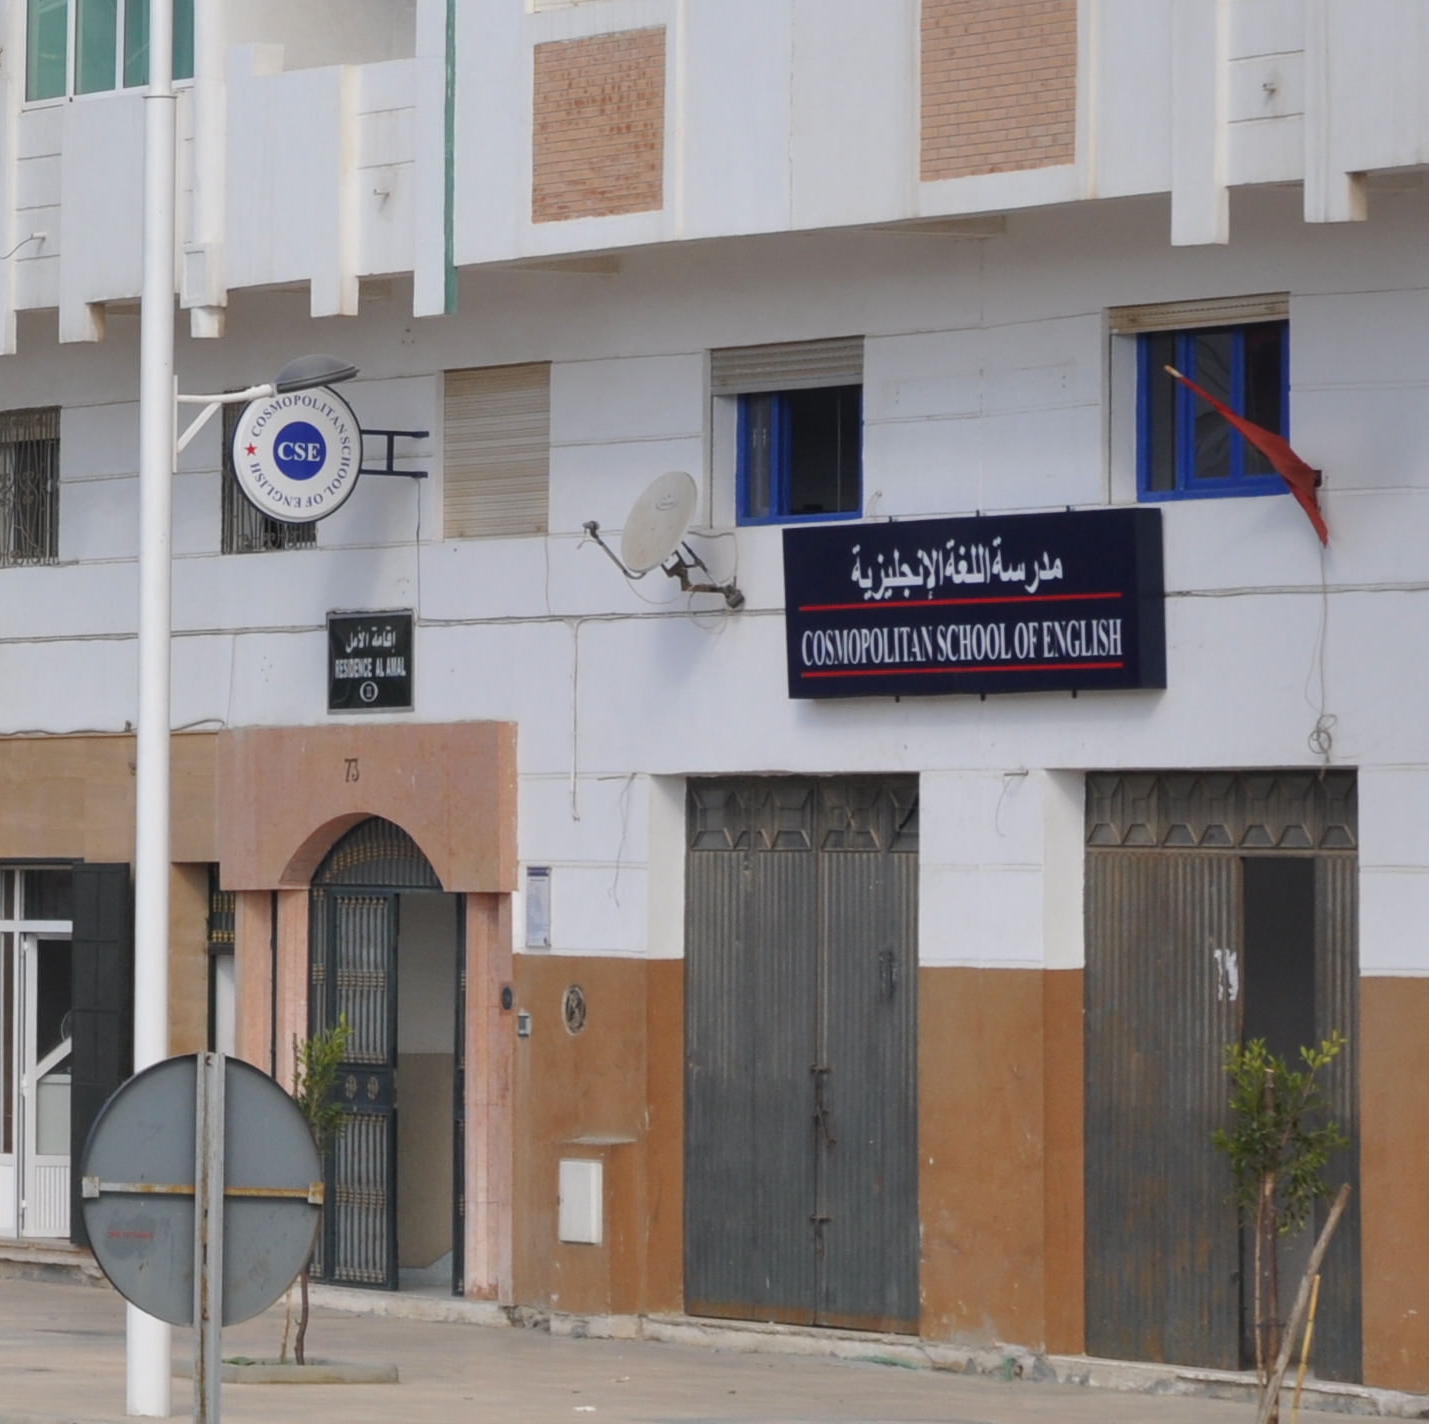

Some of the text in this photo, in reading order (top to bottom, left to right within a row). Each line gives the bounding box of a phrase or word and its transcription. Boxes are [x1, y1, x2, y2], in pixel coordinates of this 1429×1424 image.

[250, 394, 351, 508] COSMOPOLITAN SCHOOL OF ENGLISH
[277, 441, 321, 462] CSE
[851, 536, 1064, 600] مدرسة اللغة الإنجليزية
[801, 619, 1123, 667] COSMOPOLITAN SCHOOL OF ENGLISH
[335, 656, 407, 679] RESIDENCE AL AMAL
[344, 757, 360, 783] 73
